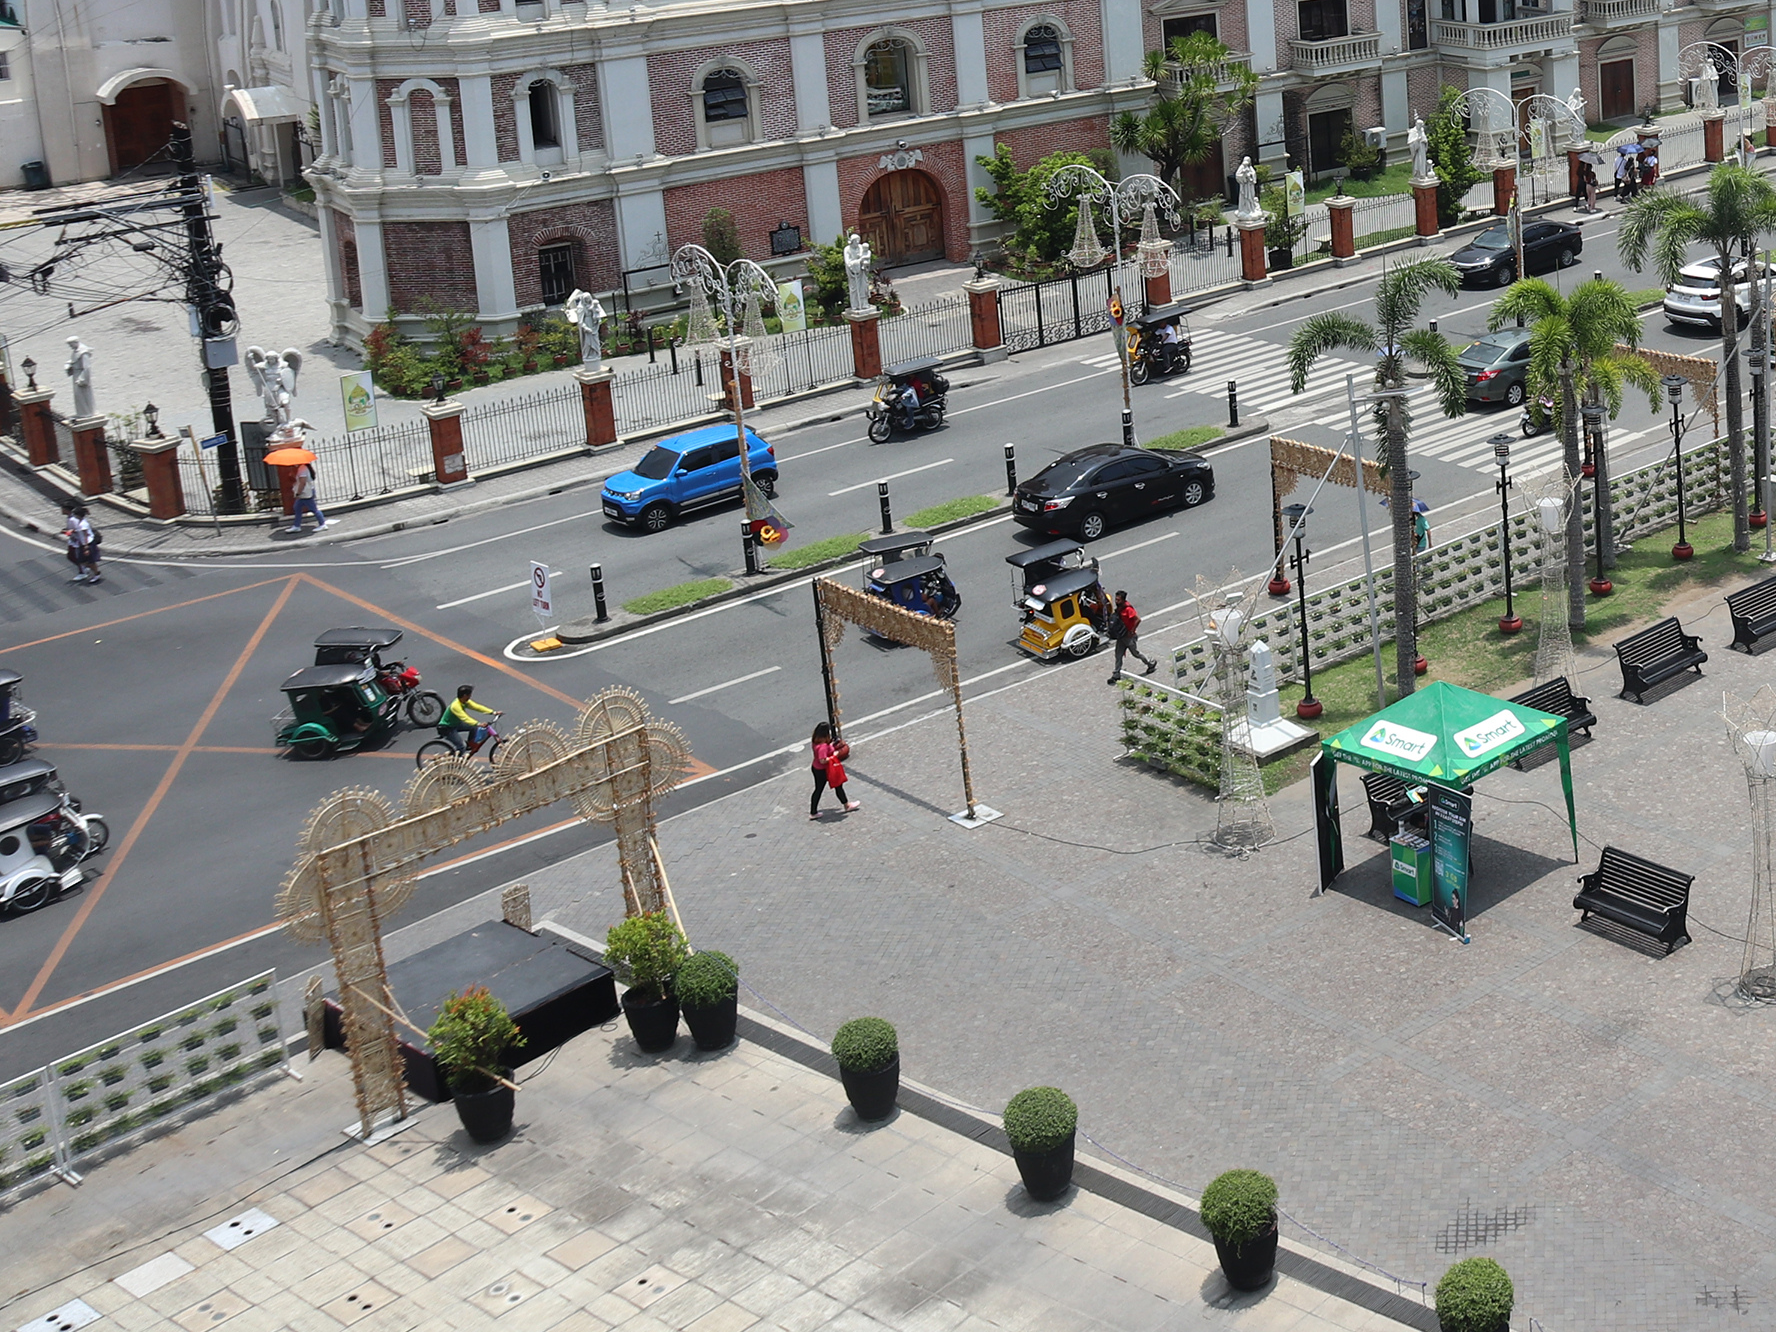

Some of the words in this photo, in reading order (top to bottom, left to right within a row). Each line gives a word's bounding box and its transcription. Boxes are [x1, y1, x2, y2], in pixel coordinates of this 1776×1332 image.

[1476, 719, 1517, 744] Smart
[1385, 733, 1426, 754] Smart
[1489, 760, 1499, 769] APP
[1519, 740, 1536, 754] LATEST
[1361, 758, 1371, 767] APP
[1393, 768, 1411, 779] LATEST
[1400, 865, 1415, 876] Smart
